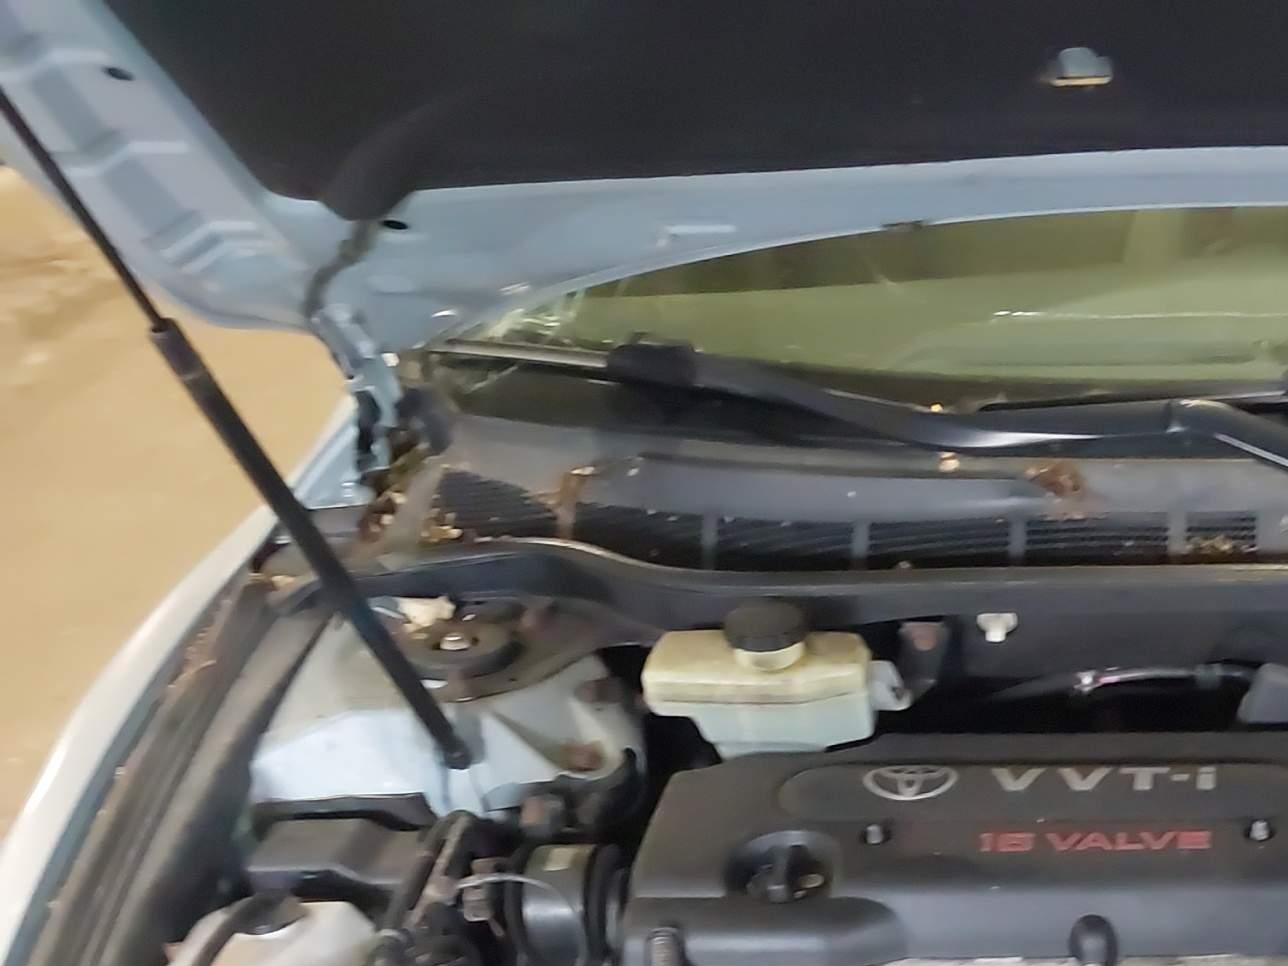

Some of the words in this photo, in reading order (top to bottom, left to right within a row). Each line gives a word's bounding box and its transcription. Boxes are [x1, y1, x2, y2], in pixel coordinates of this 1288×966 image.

[991, 767, 1217, 792] VVT-i
[979, 832, 1036, 852] 16
[1045, 831, 1213, 851] VALVE
